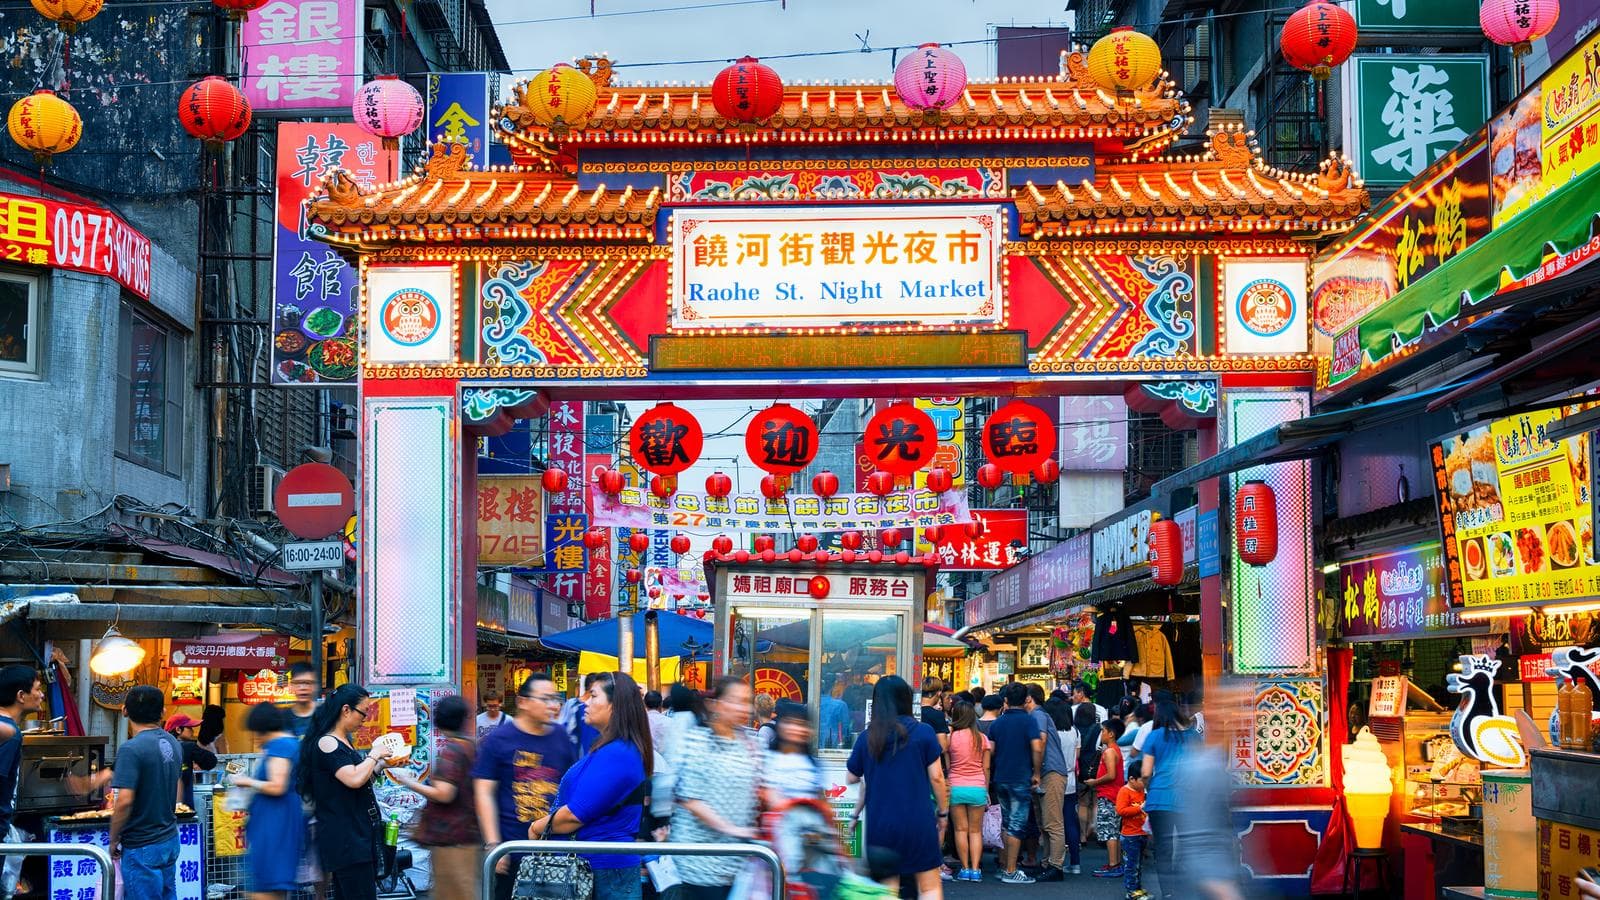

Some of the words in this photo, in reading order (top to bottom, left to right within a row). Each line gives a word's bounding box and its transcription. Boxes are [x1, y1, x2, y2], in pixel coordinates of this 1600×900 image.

[257, 1, 343, 102] 銀樓
[924, 50, 939, 96] 天上聖母
[547, 67, 562, 109] 天上聖母
[736, 64, 750, 112] 天上聖母
[20, 98, 37, 140] 天上聖母
[434, 102, 480, 144] 金
[1370, 64, 1470, 177] 藥
[289, 134, 350, 301] 韓館
[693, 230, 982, 268] 饒河街觀光夜市
[689, 282, 760, 302] Raohe
[776, 283, 804, 301] St.
[820, 281, 882, 304] Night
[900, 279, 986, 299] Market
[639, 417, 690, 466] 歡
[762, 420, 811, 467] 迎
[874, 419, 925, 461] 光
[989, 417, 1038, 456] 臨
[285, 547, 341, 562] 16:00-24:00
[553, 517, 584, 569] 光樓
[653, 529, 669, 568] IRKEN
[733, 574, 810, 594] 媽祖廟口
[849, 577, 909, 597] 服務台
[178, 824, 200, 900] 胡椒
